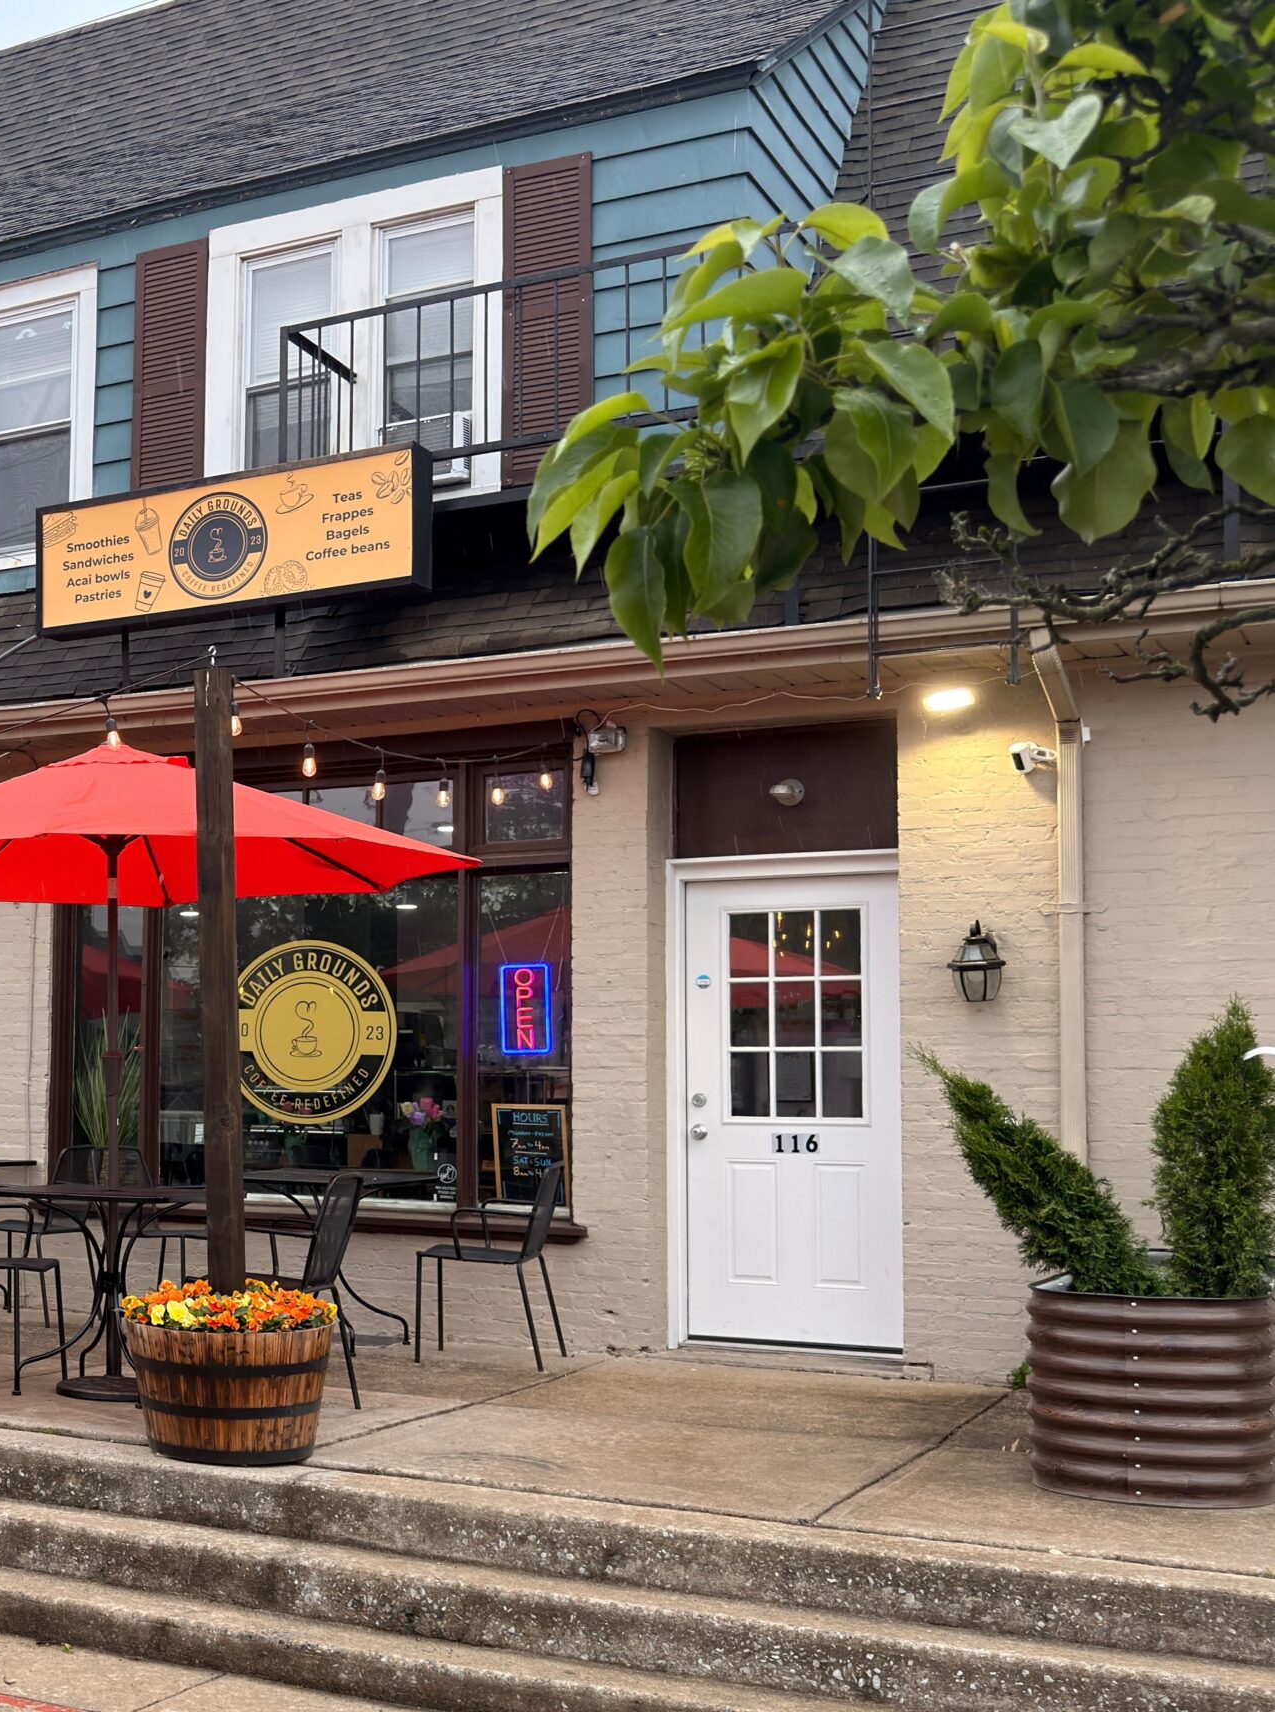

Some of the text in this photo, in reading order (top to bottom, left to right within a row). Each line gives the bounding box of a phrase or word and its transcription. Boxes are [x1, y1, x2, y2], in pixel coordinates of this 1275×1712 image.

[332, 490, 363, 504] Teas
[179, 498, 258, 537] DAILY GROUNDS
[321, 506, 374, 524] Frappes
[250, 534, 262, 546] 23
[326, 524, 370, 541] Bagels
[66, 534, 130, 554] Smoothies
[174, 547, 185, 558] 20
[305, 539, 390, 562] Coffee beans
[62, 551, 134, 572] Sandwiches
[66, 569, 130, 588] Acai bowls
[181, 560, 254, 593] COFFEE REDEFINED
[74, 588, 122, 604] Pastries
[240, 952, 378, 1008] DAILY GROUNDS
[514, 968, 535, 1049] OPEN
[366, 1026, 384, 1040] 23
[244, 1064, 369, 1111] COFFEE REDEFINED
[513, 1111, 549, 1123] HOURS
[775, 1133, 819, 1153] 116
[513, 1155, 529, 1165] SAT
[534, 1157, 552, 1167] SUN
